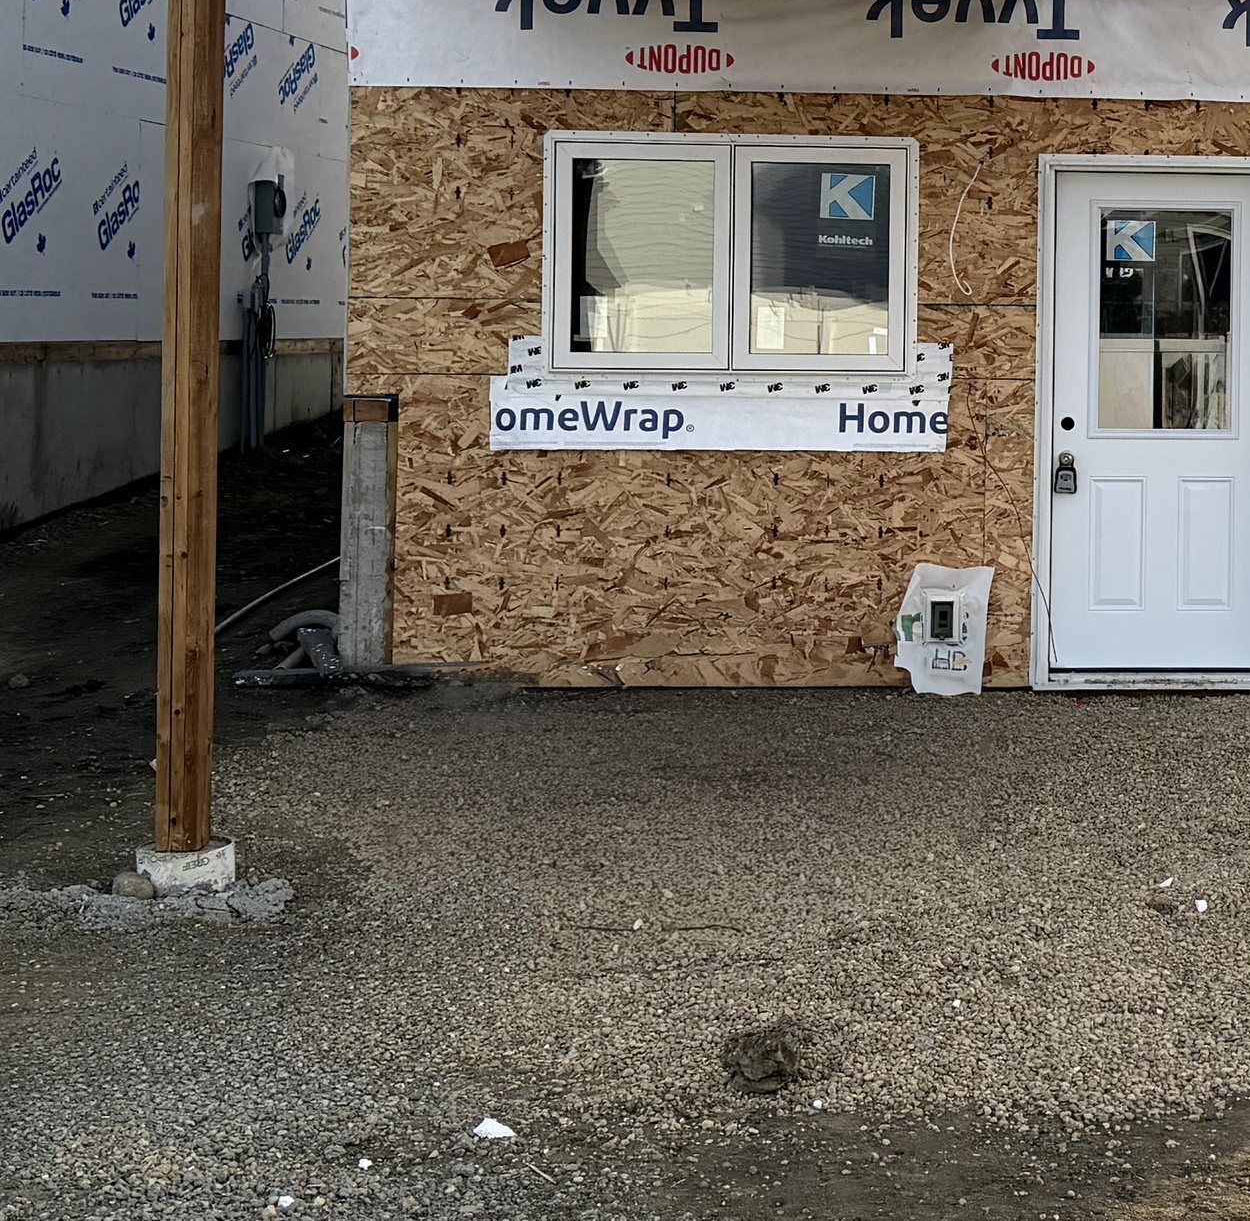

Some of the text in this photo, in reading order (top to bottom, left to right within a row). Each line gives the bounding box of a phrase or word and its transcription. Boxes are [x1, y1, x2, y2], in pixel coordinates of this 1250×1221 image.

[278, 43, 316, 105] GlasRoc
[637, 44, 721, 74] DUPONT
[1002, 51, 1082, 81] DUPONT
[2, 157, 62, 245] GlasRoc
[285, 198, 321, 265] GlasRoc
[818, 234, 873, 246] Kohltech
[527, 346, 542, 356] 3M
[526, 378, 925, 395] 3M 3M 3M 3M 3M 3M 3M 3M 3M
[839, 403, 949, 434] Home
[182, 857, 209, 871] GREIF
